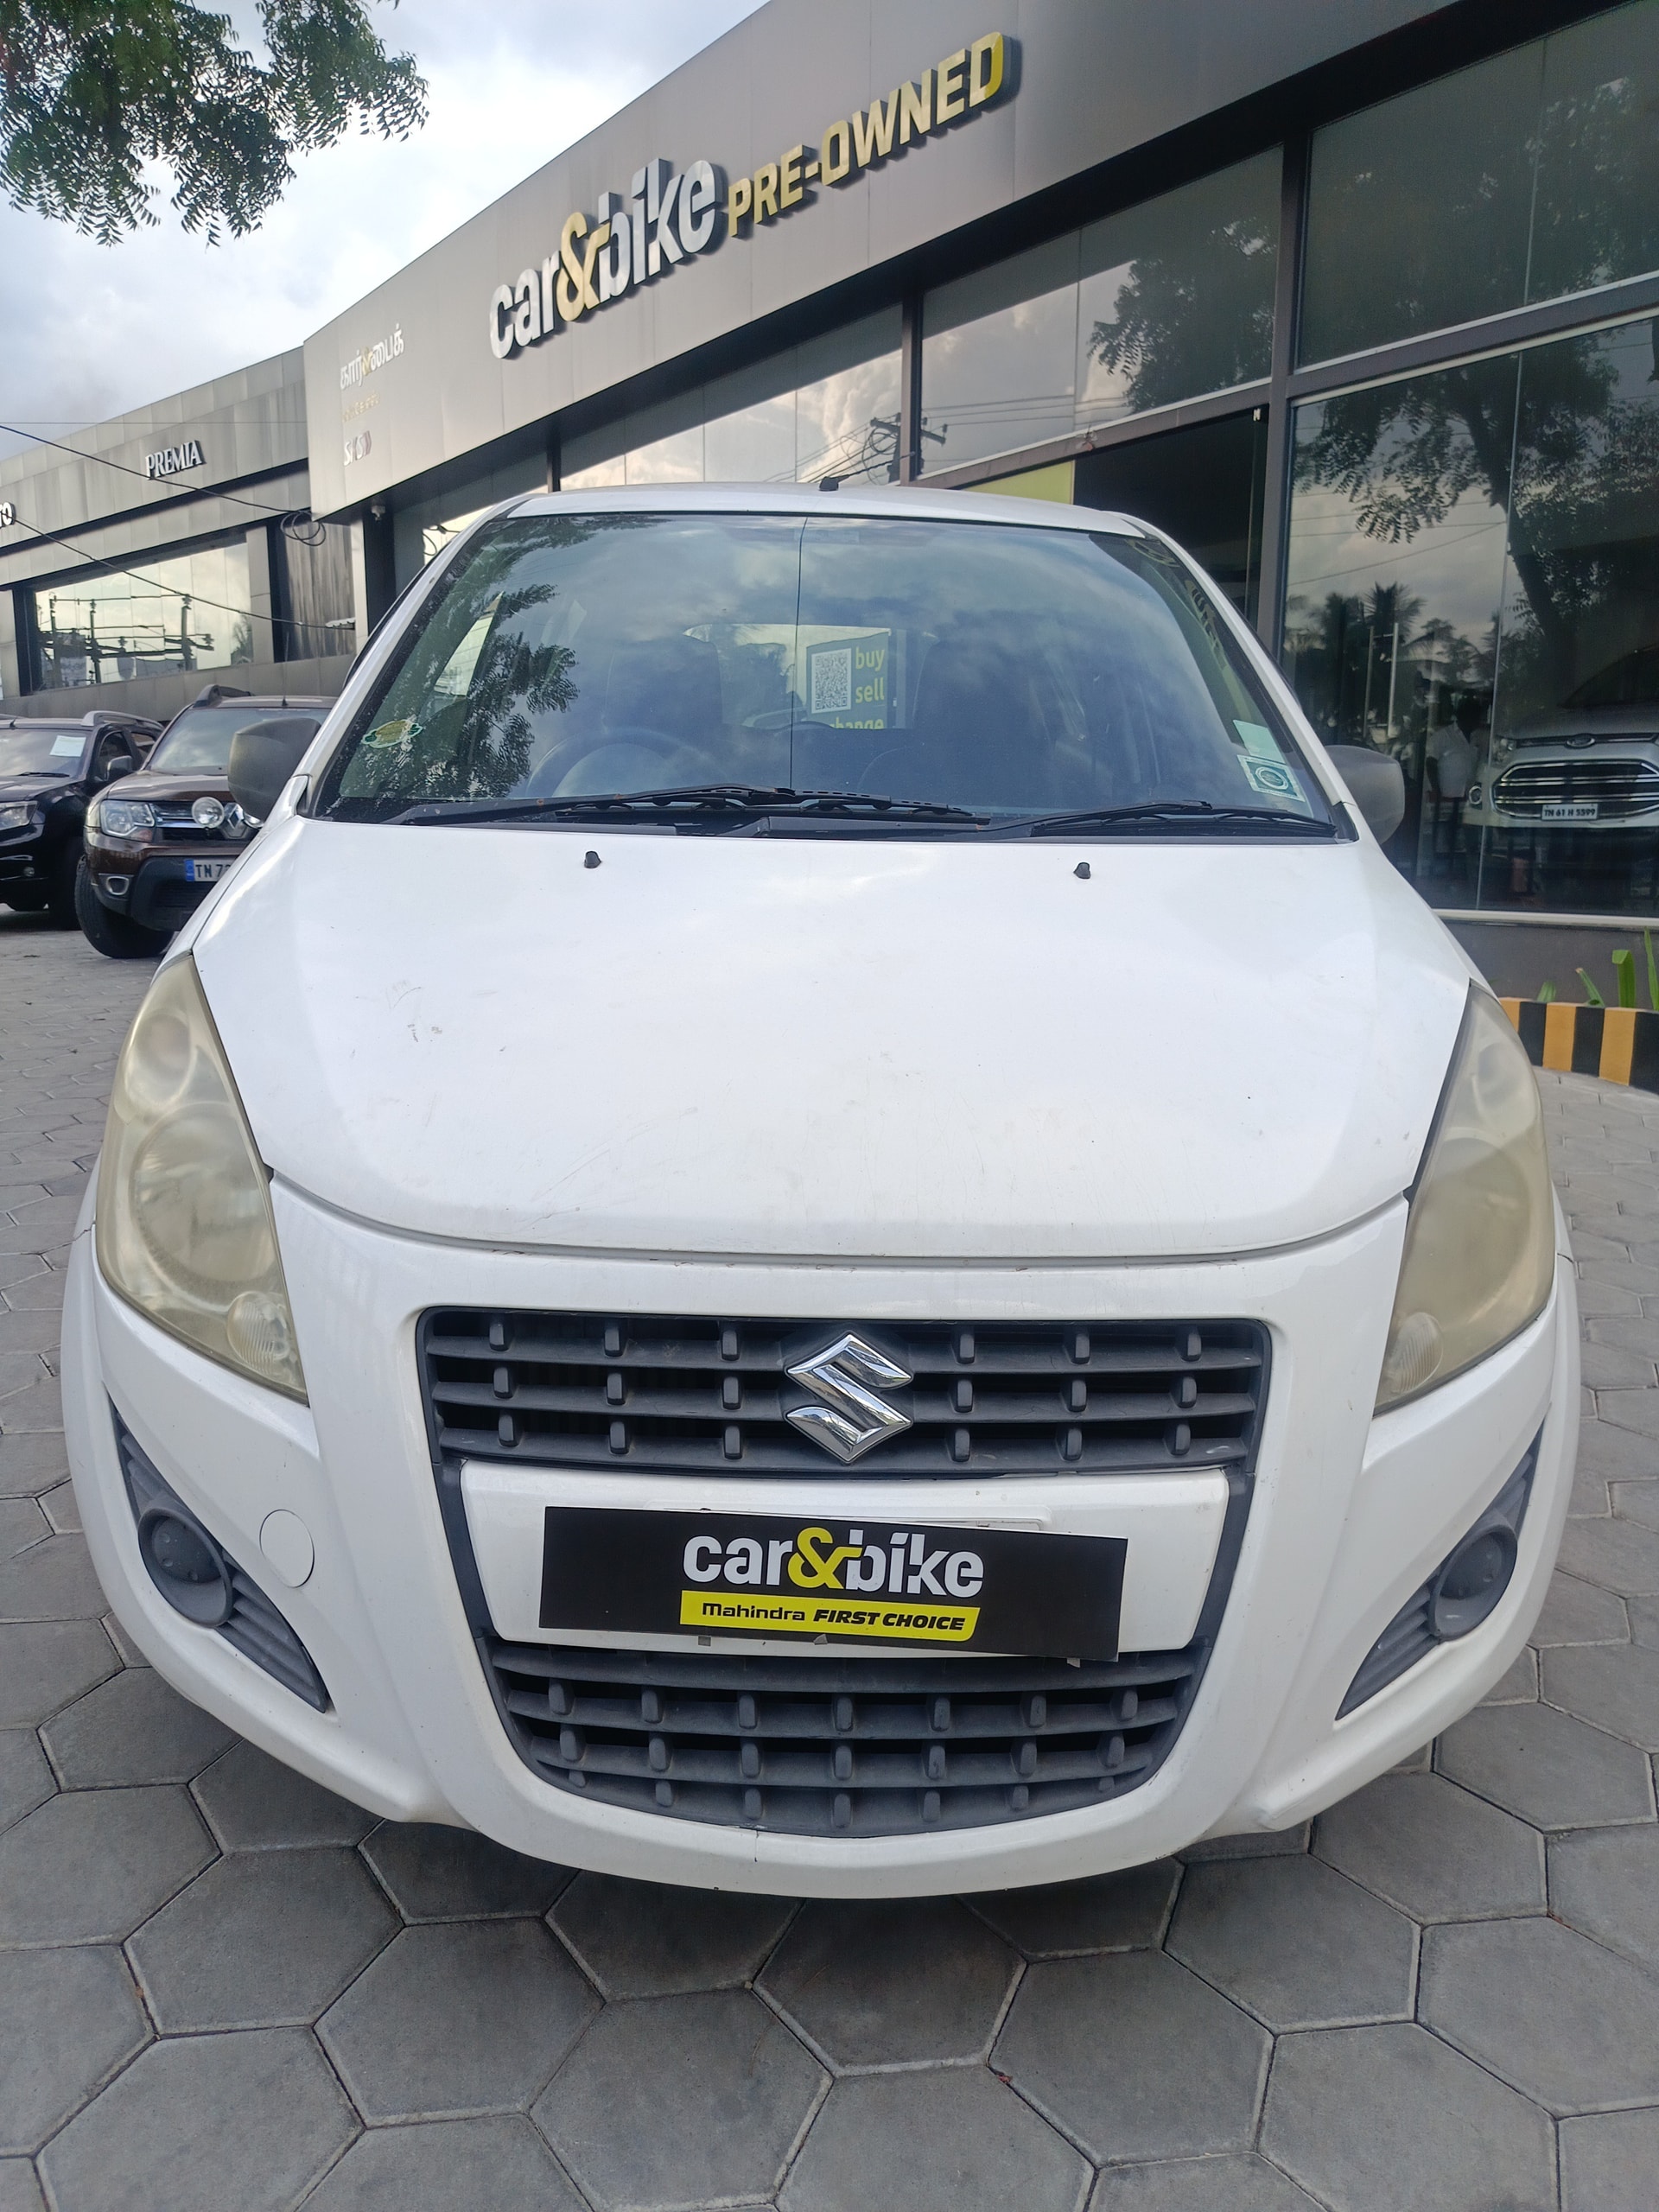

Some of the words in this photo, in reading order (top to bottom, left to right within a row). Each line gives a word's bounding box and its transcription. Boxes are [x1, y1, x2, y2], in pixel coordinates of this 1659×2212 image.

[490, 158, 719, 359] car&bike
[728, 31, 1016, 238] PRE-OWNED
[145, 441, 204, 480] PREMIA
[856, 646, 884, 671] buy
[855, 677, 885, 703] sell
[195, 864, 213, 878] TN
[683, 1526, 985, 1599] car&bike
[702, 1602, 805, 1621] Mahindra
[813, 1608, 880, 1626] FIRST
[882, 1612, 966, 1631] CHOICE
